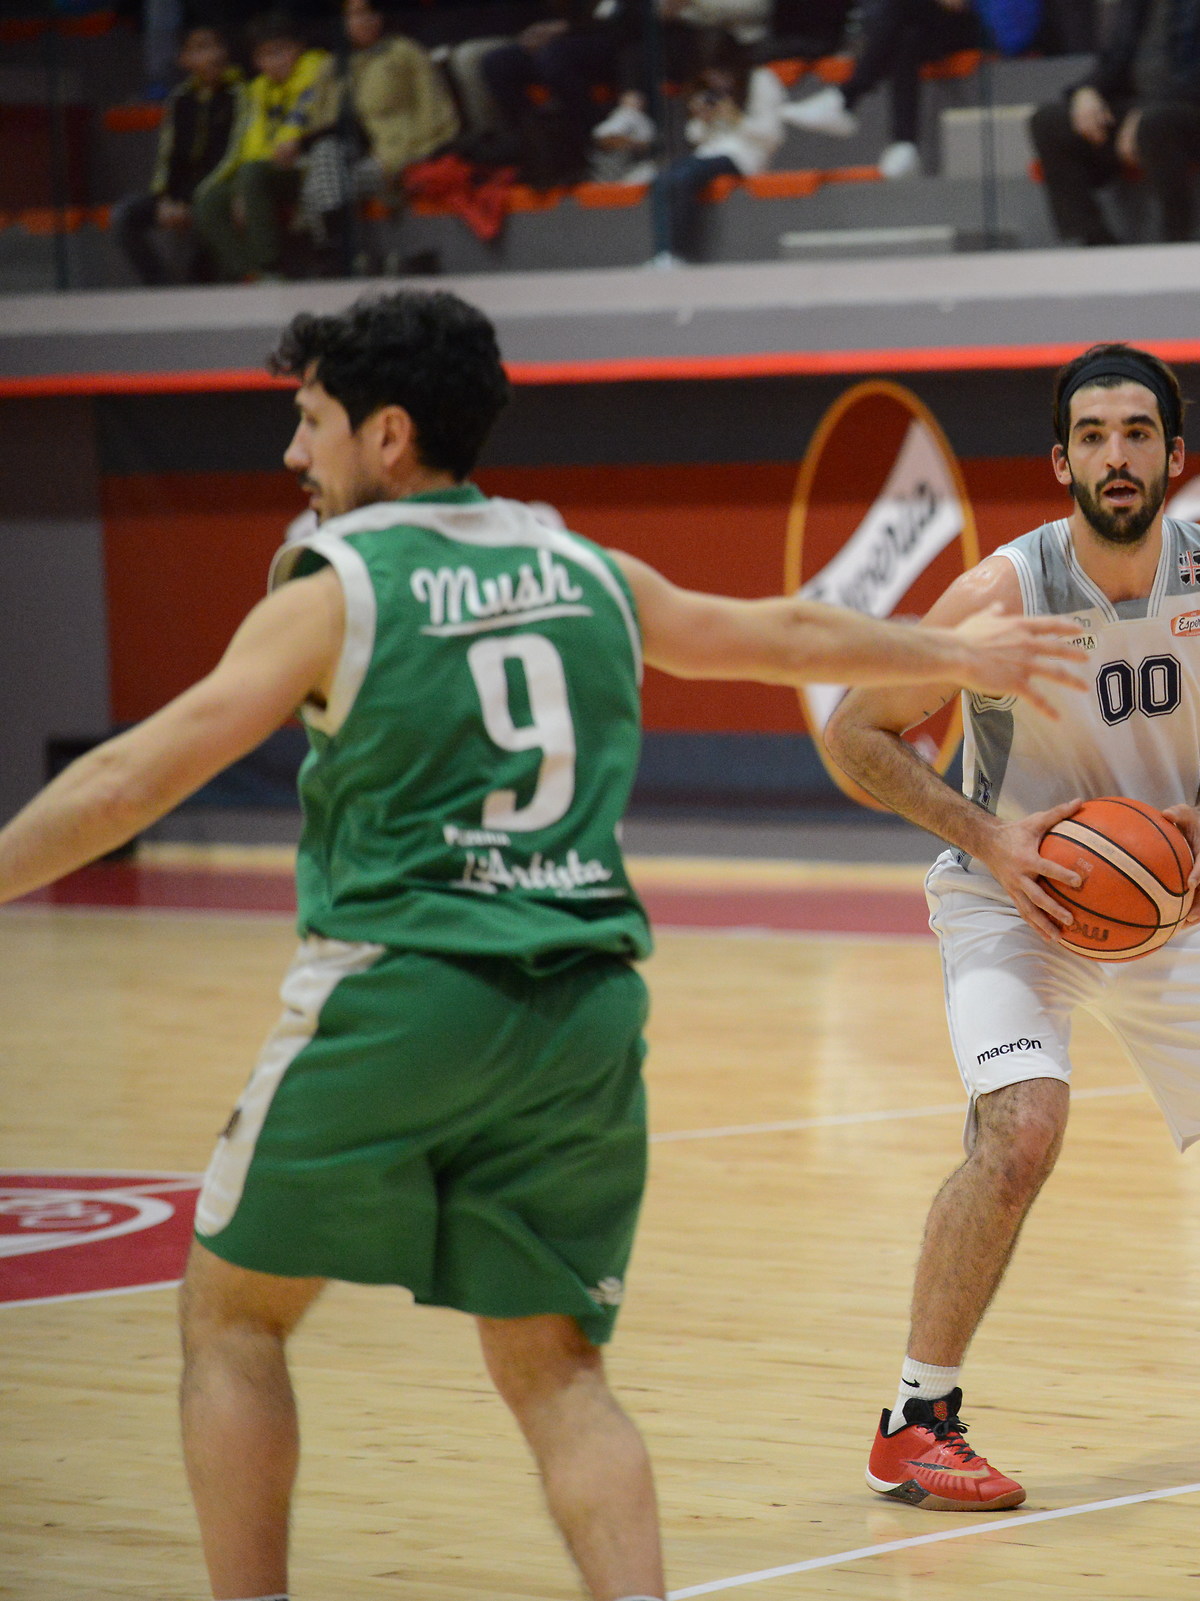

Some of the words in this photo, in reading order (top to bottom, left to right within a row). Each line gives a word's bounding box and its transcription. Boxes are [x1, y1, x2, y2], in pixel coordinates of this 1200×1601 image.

[410, 548, 584, 625] Mush
[1096, 653, 1182, 727] 00
[466, 633, 576, 833] 9
[976, 1037, 1042, 1065] macron
